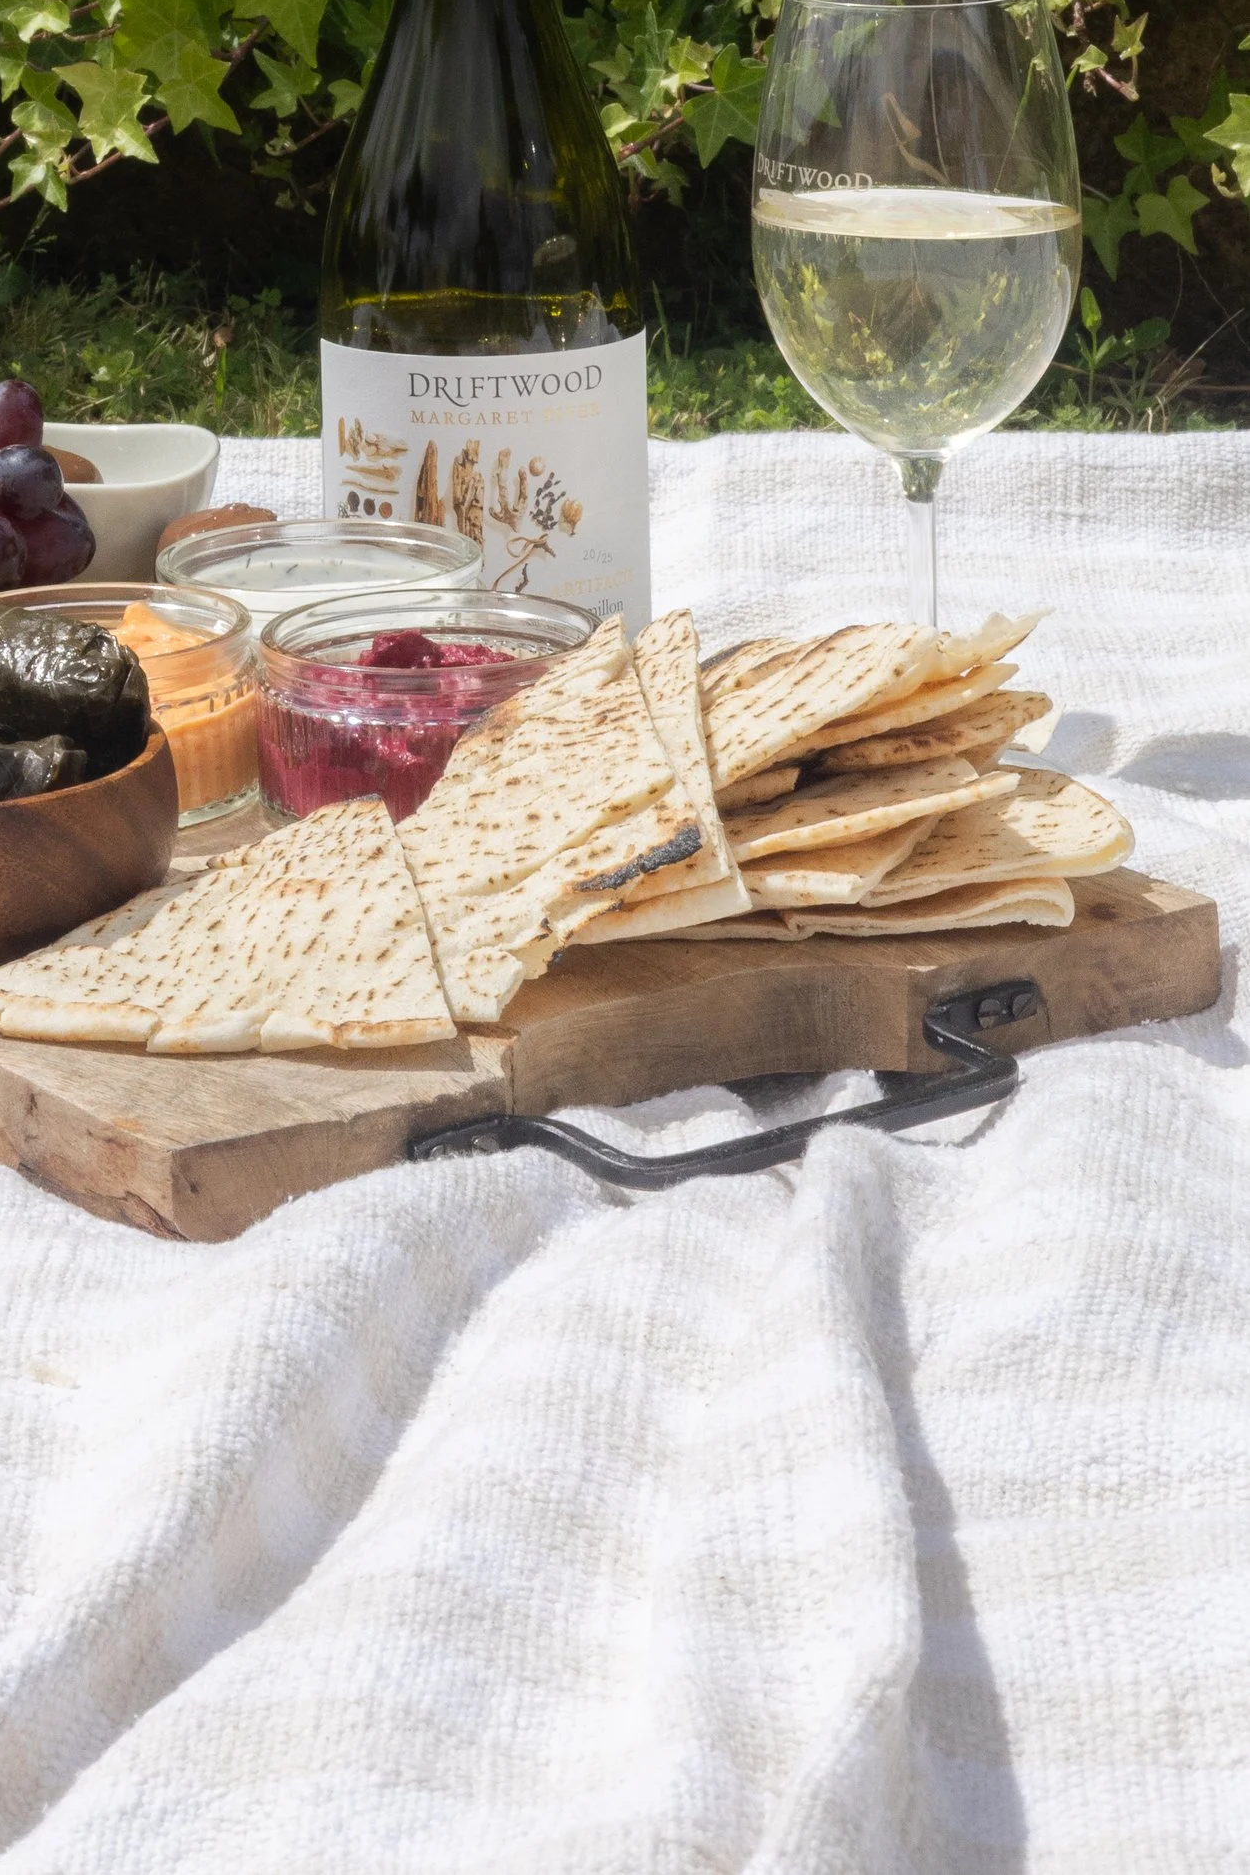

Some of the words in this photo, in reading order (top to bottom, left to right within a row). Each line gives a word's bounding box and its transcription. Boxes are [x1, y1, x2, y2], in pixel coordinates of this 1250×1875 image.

[757, 153, 872, 192] DRIFTWOOD
[408, 364, 603, 408] DRIFTWOOD
[410, 409, 533, 426] MARGARET
[583, 548, 613, 564] 20/25
